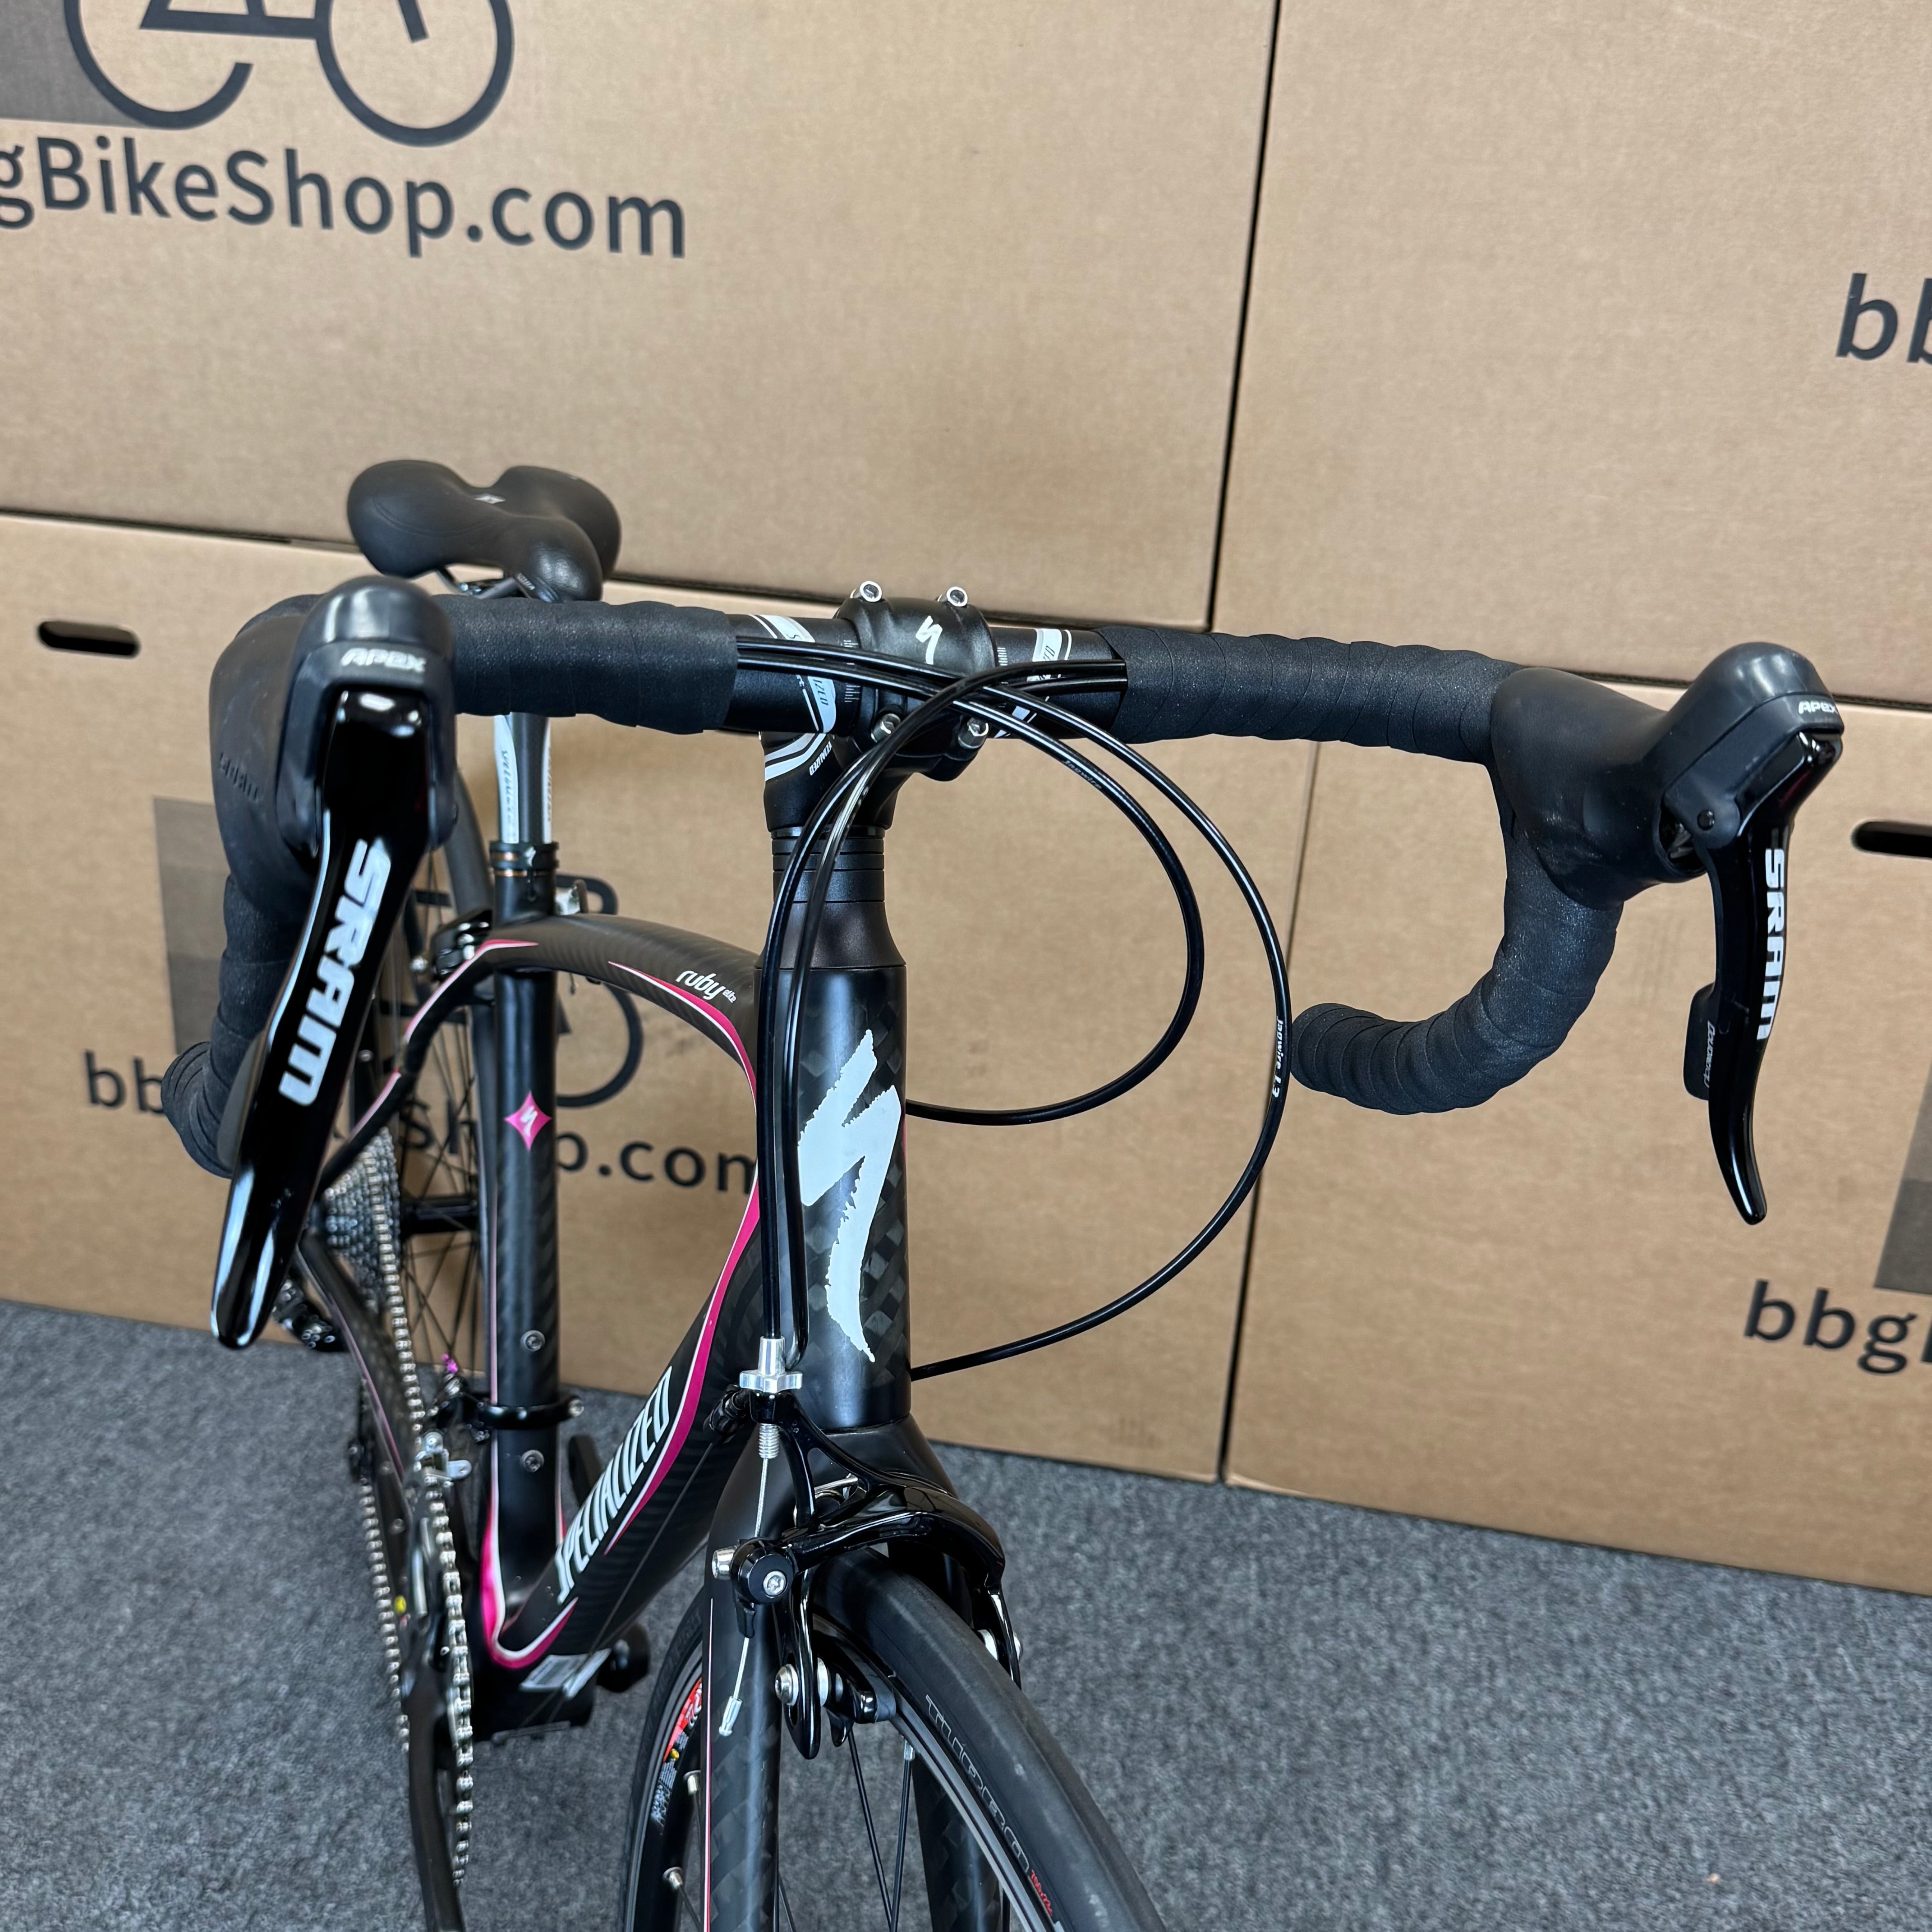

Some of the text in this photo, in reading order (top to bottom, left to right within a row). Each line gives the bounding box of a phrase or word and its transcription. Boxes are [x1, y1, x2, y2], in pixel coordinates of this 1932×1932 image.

[278, 837, 391, 1107] SRAM
[675, 970, 726, 1000] ruby
[1756, 848, 1785, 1040] SRAM
[1744, 1279, 1932, 1374] bbg
[555, 1366, 672, 1605] SPECIALIZED
